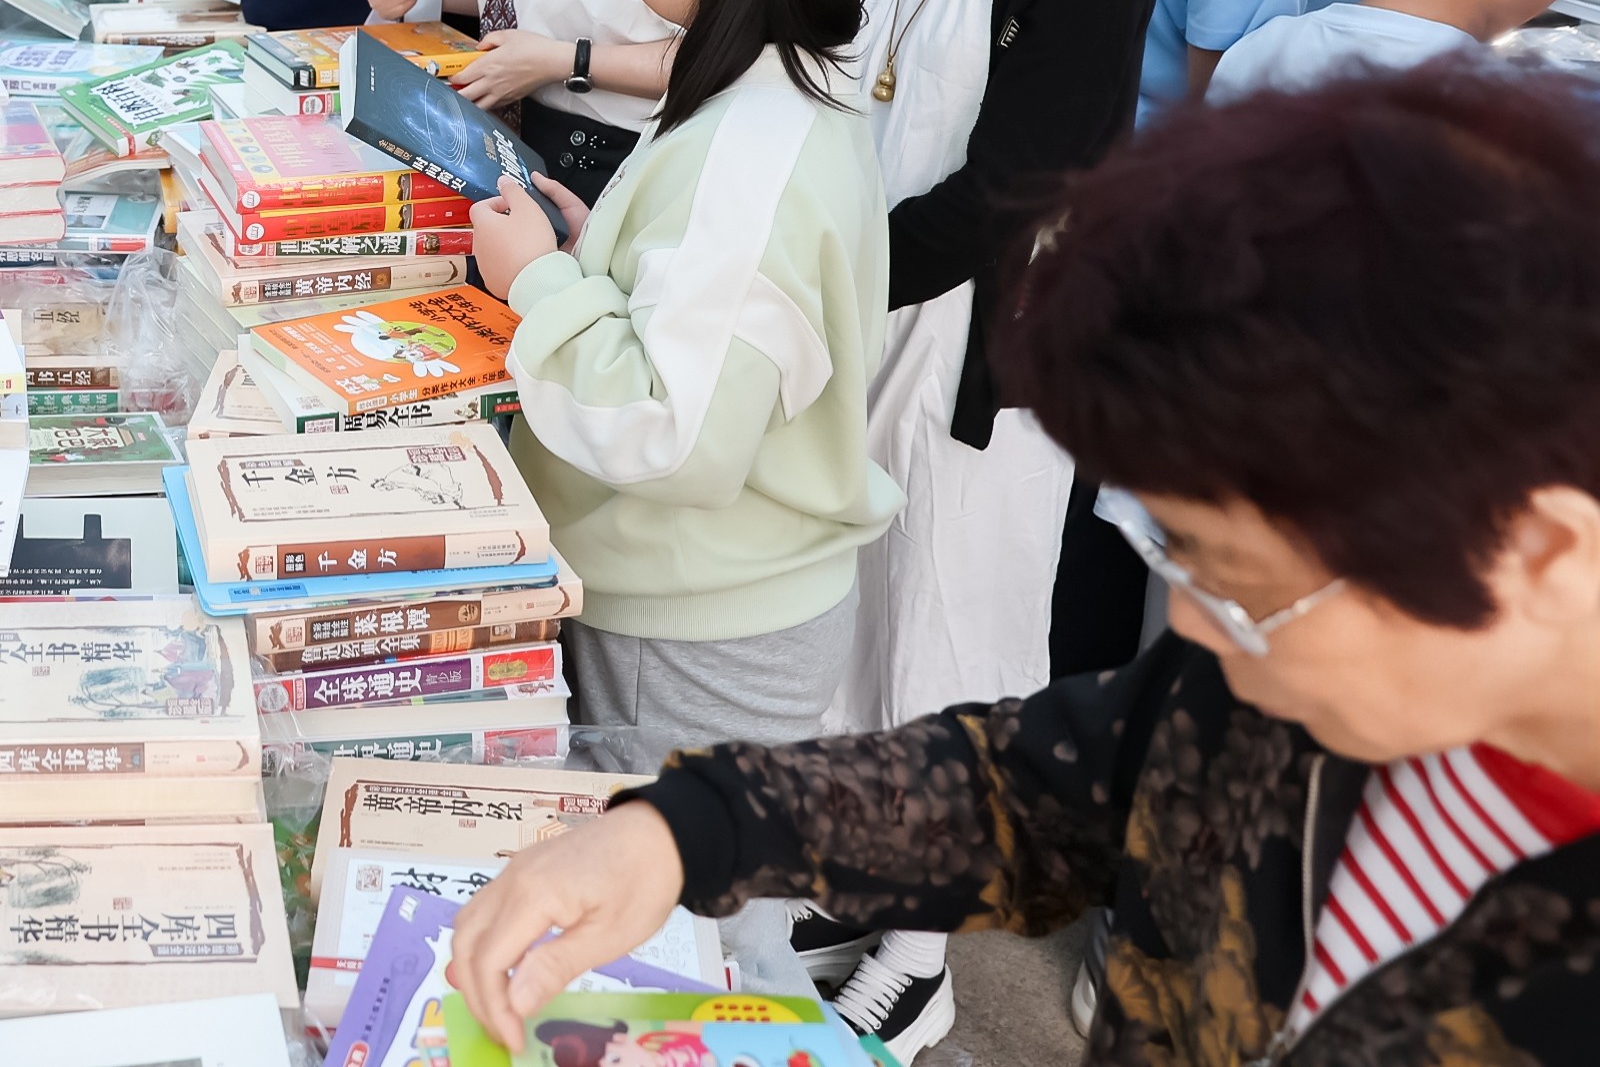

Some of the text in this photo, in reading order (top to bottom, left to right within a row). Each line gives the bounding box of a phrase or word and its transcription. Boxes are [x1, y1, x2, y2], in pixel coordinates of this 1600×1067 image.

[412, 155, 467, 191] 时间简史
[280, 235, 402, 255] 世界未解之谜
[295, 271, 372, 296] 黄帝内经
[343, 404, 433, 433] 周易全书
[241, 465, 361, 488] 千金方
[316, 547, 398, 572] 千金方
[354, 606, 431, 636] 菜根谭
[312, 667, 462, 704] 全球通史 青少版
[360, 792, 526, 822] 黄帝内经
[9, 912, 239, 944] 四库全书精华
